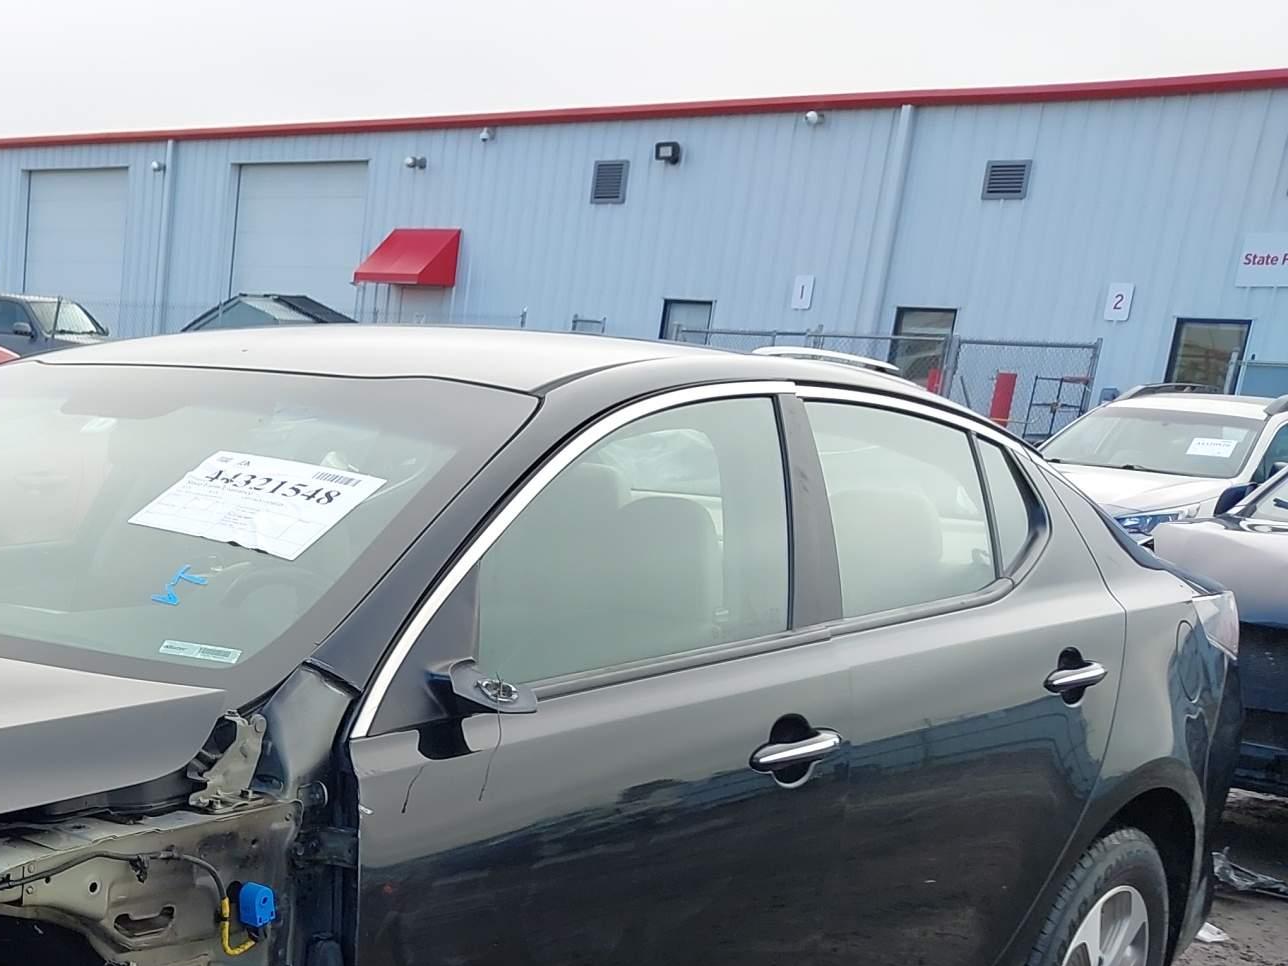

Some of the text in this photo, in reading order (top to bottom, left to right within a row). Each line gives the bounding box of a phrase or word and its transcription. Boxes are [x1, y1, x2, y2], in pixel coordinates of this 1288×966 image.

[1243, 253, 1279, 266] State
[1113, 293, 1124, 310] 2
[205, 470, 341, 505] 44321548
